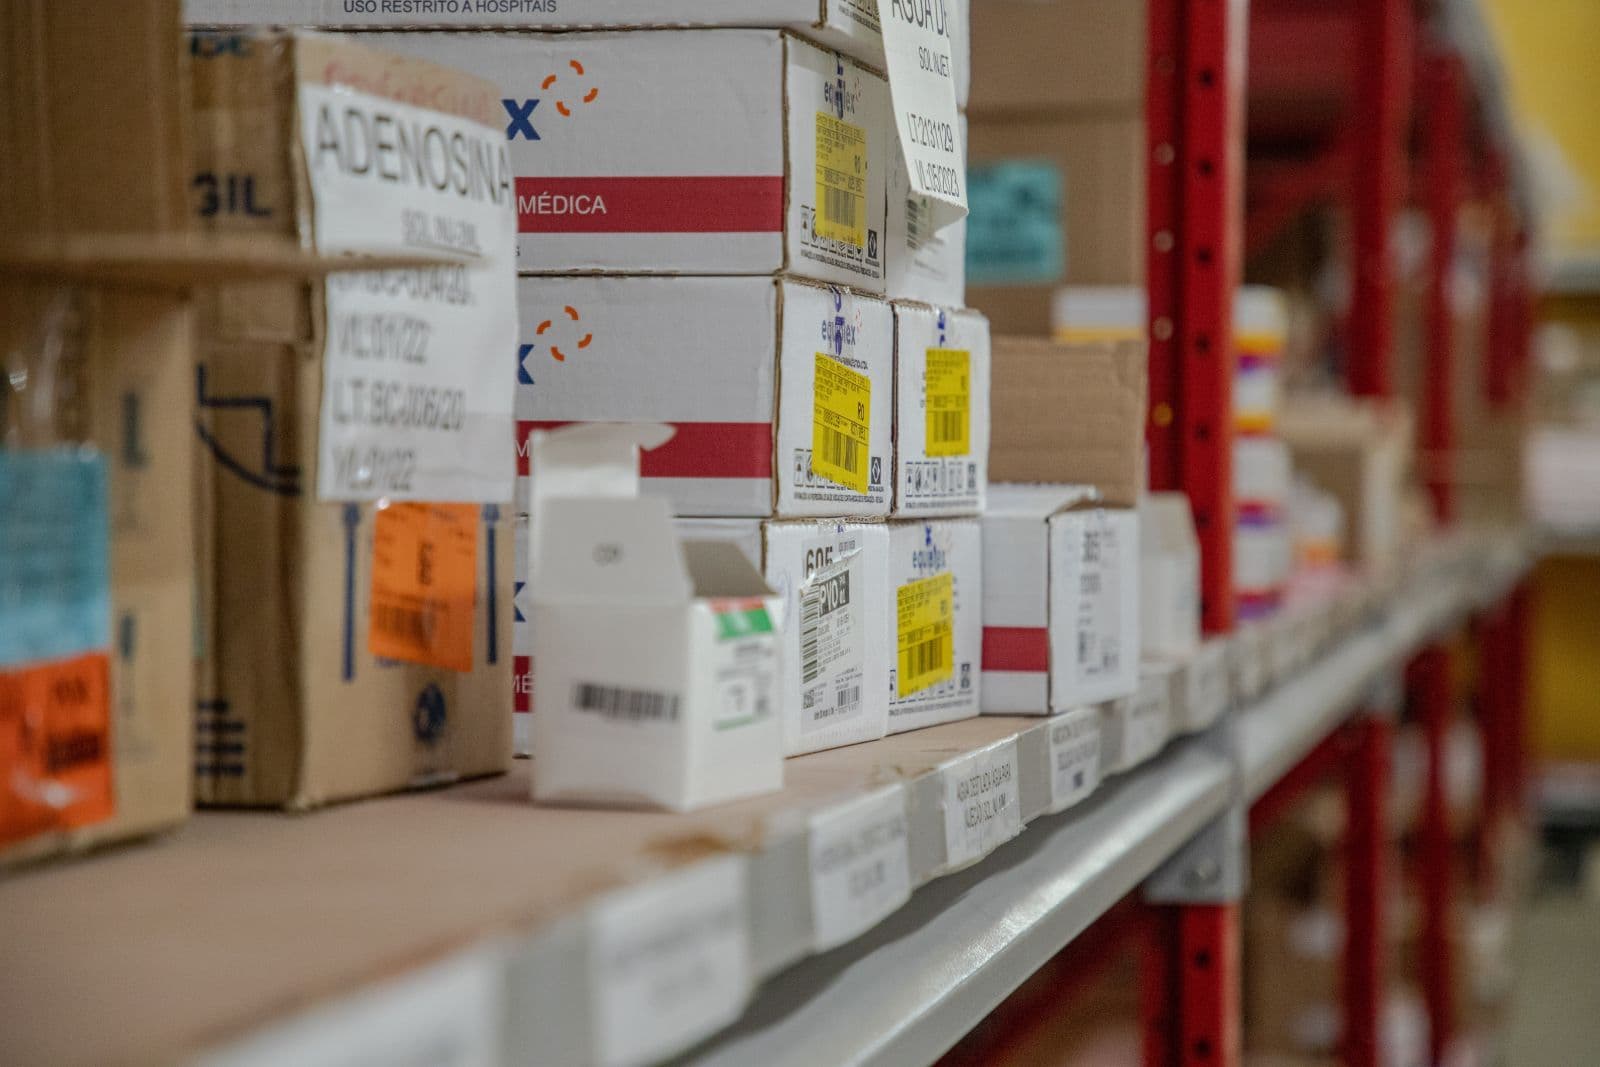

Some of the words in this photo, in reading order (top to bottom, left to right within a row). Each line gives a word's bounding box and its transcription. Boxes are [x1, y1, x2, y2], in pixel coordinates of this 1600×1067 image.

[343, 0, 377, 13] USO
[381, 0, 459, 13] RESTRITO
[461, 0, 473, 13] A
[476, 0, 557, 13] HOSPITAIS
[315, 105, 512, 207] ADENOSINA
[518, 191, 607, 215] MÉDICA
